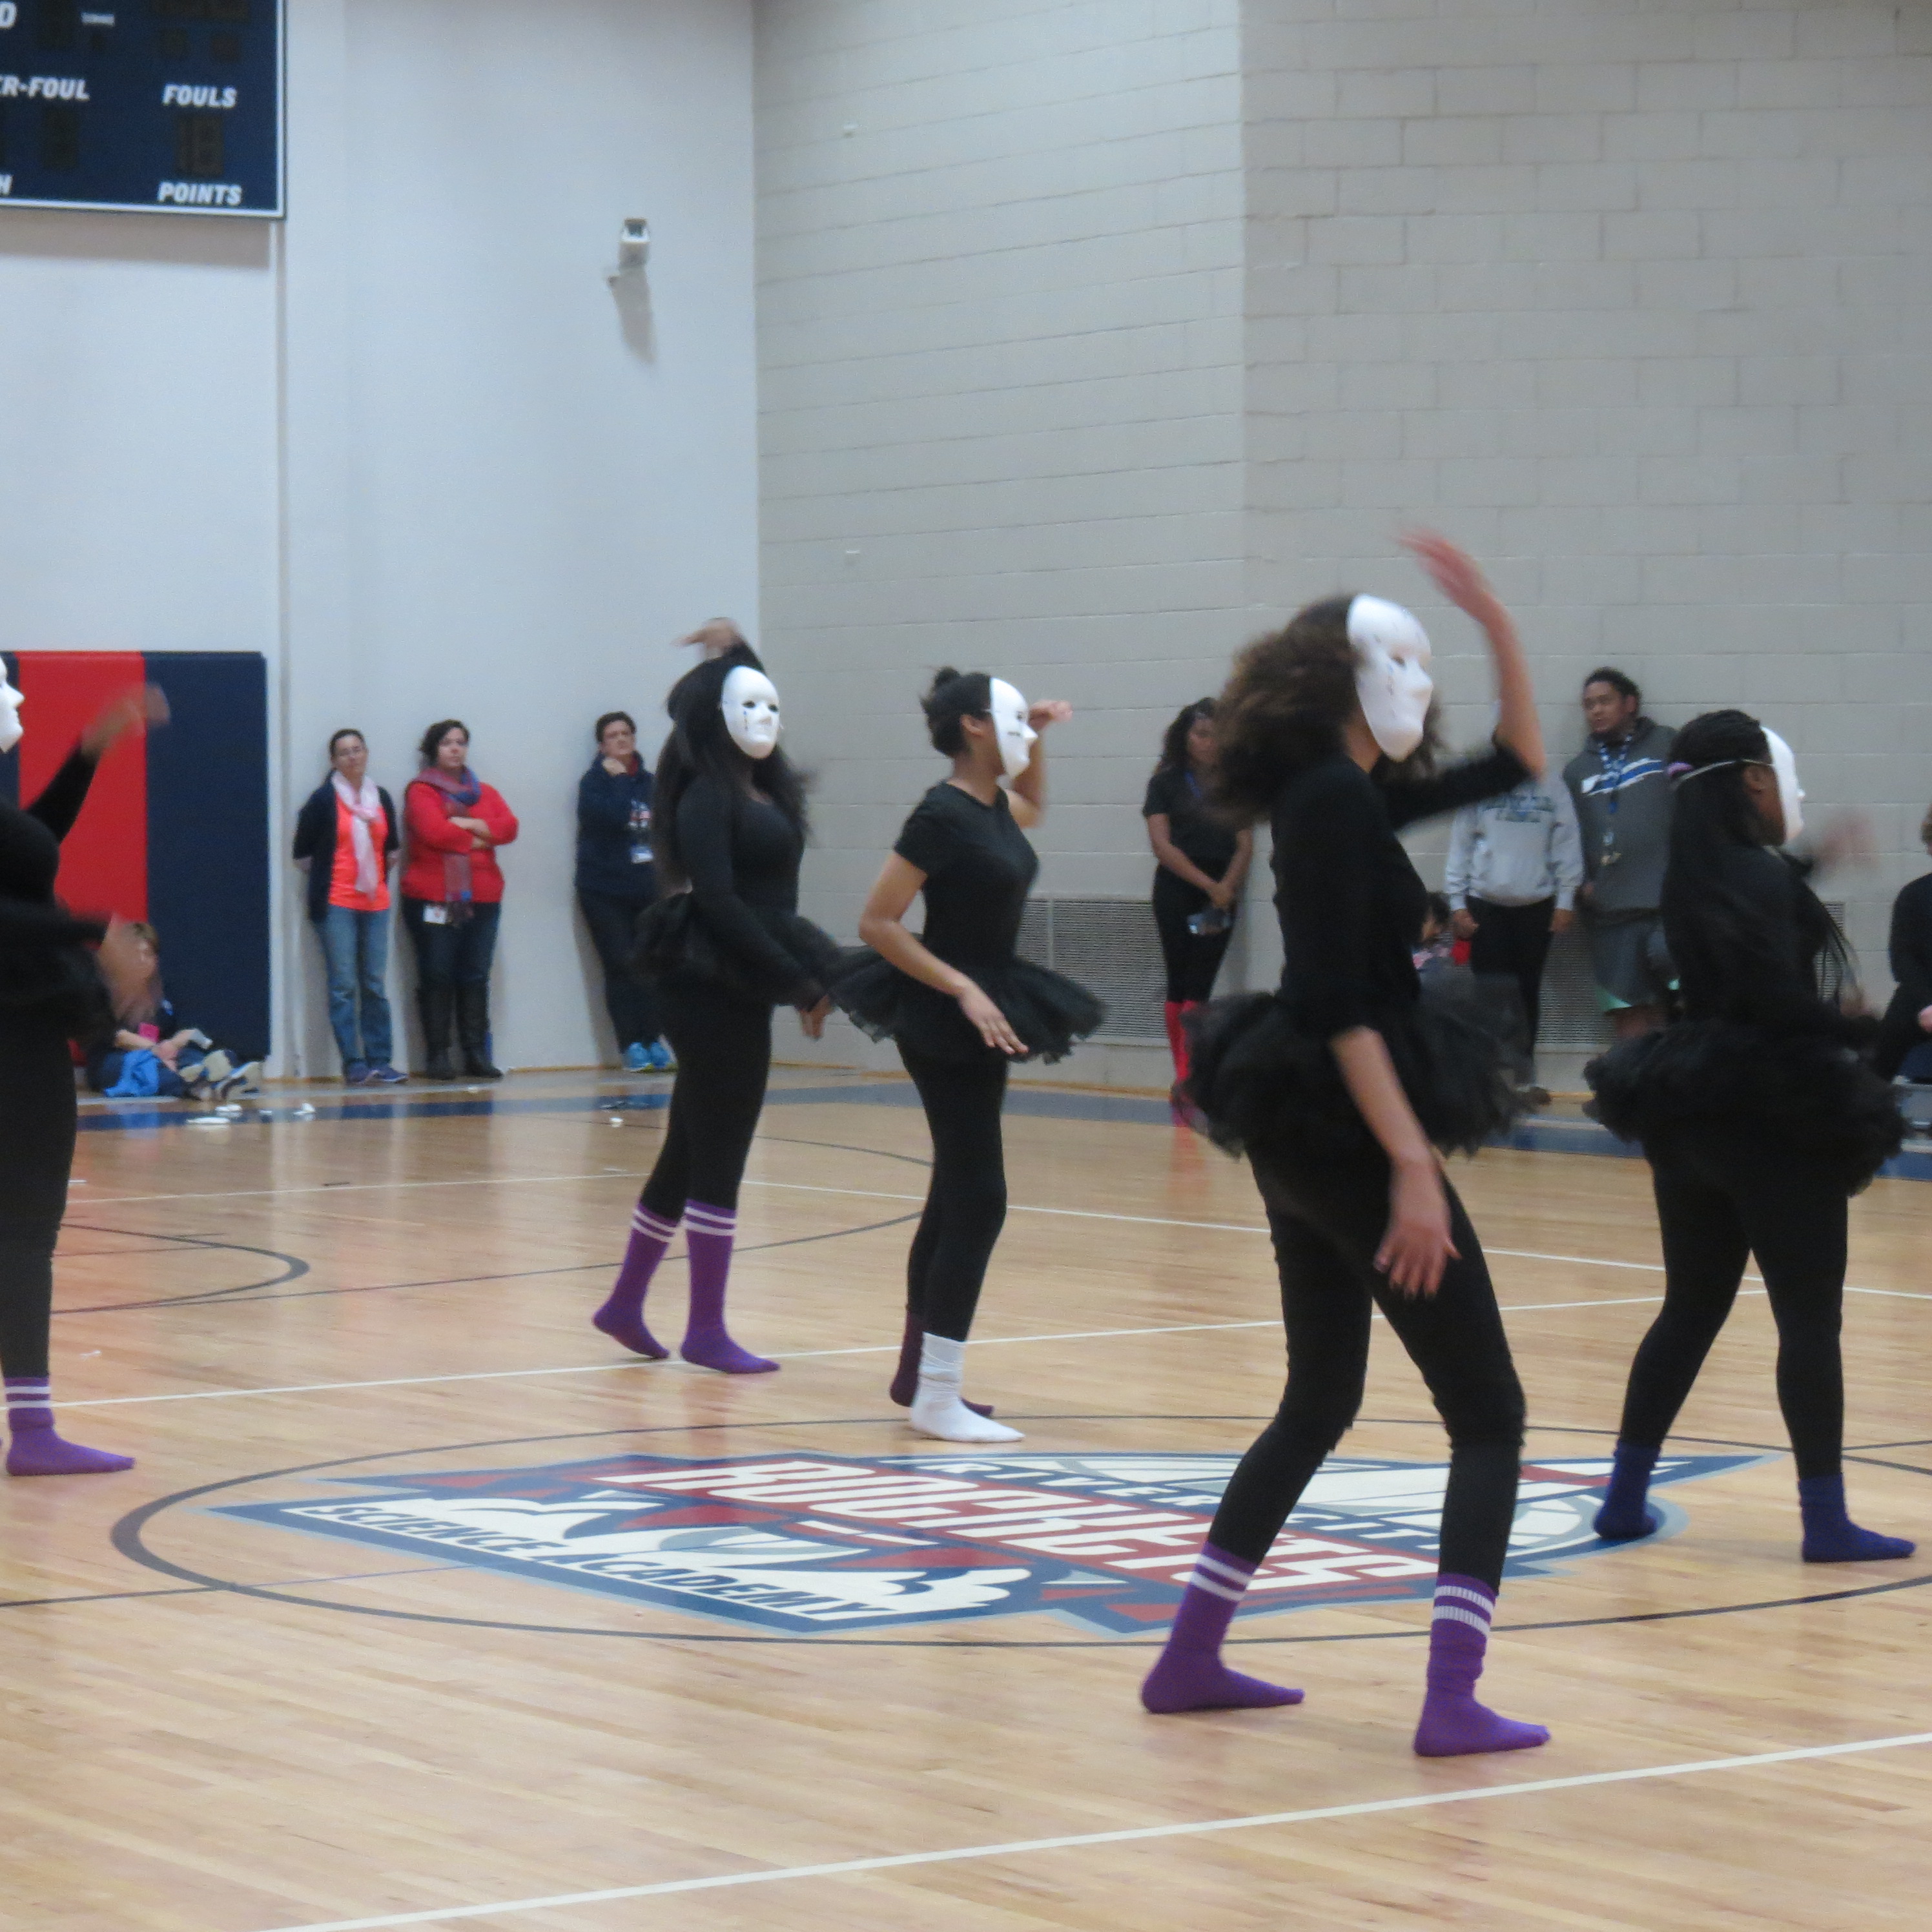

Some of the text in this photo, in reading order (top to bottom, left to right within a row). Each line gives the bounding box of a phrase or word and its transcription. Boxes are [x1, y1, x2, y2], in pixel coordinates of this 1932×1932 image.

[0, 74, 90, 100] R-FOUL
[162, 84, 238, 108] FOULS
[157, 181, 242, 206] POINTS
[591, 1461, 1439, 1590] ROCKETS
[916, 1463, 1441, 1550] RIVER CIT
[302, 1506, 898, 1614] SCIENCE ACADEMY
